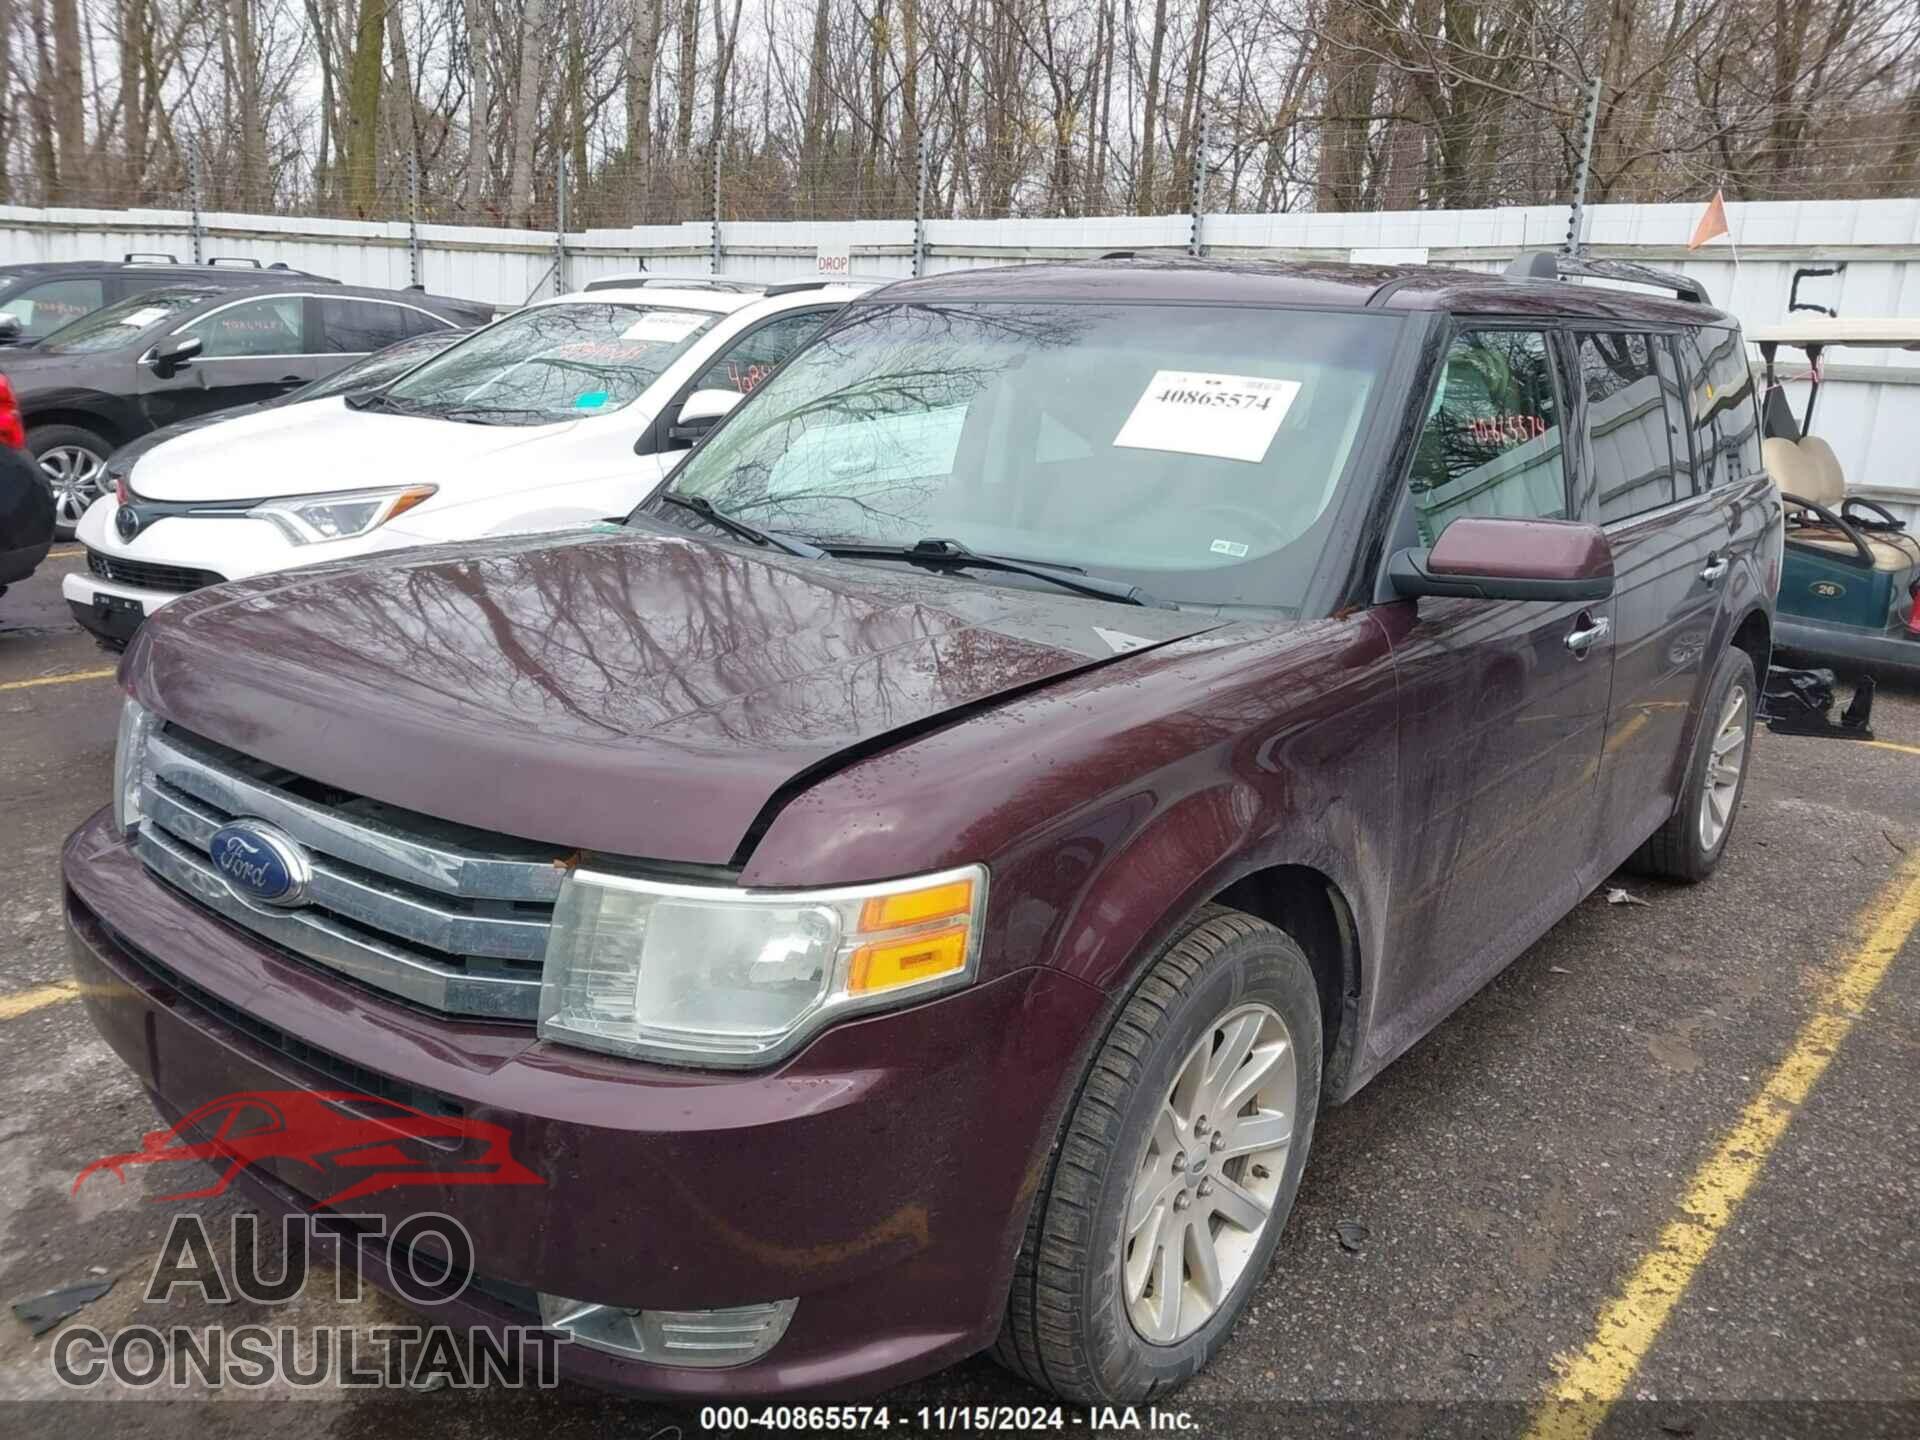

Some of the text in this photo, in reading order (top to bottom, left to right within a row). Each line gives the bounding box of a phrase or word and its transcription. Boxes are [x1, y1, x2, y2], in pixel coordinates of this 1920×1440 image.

[818, 256, 848, 270] DROP
[1155, 388, 1272, 411] 40865574
[220, 836, 272, 887] Ford
